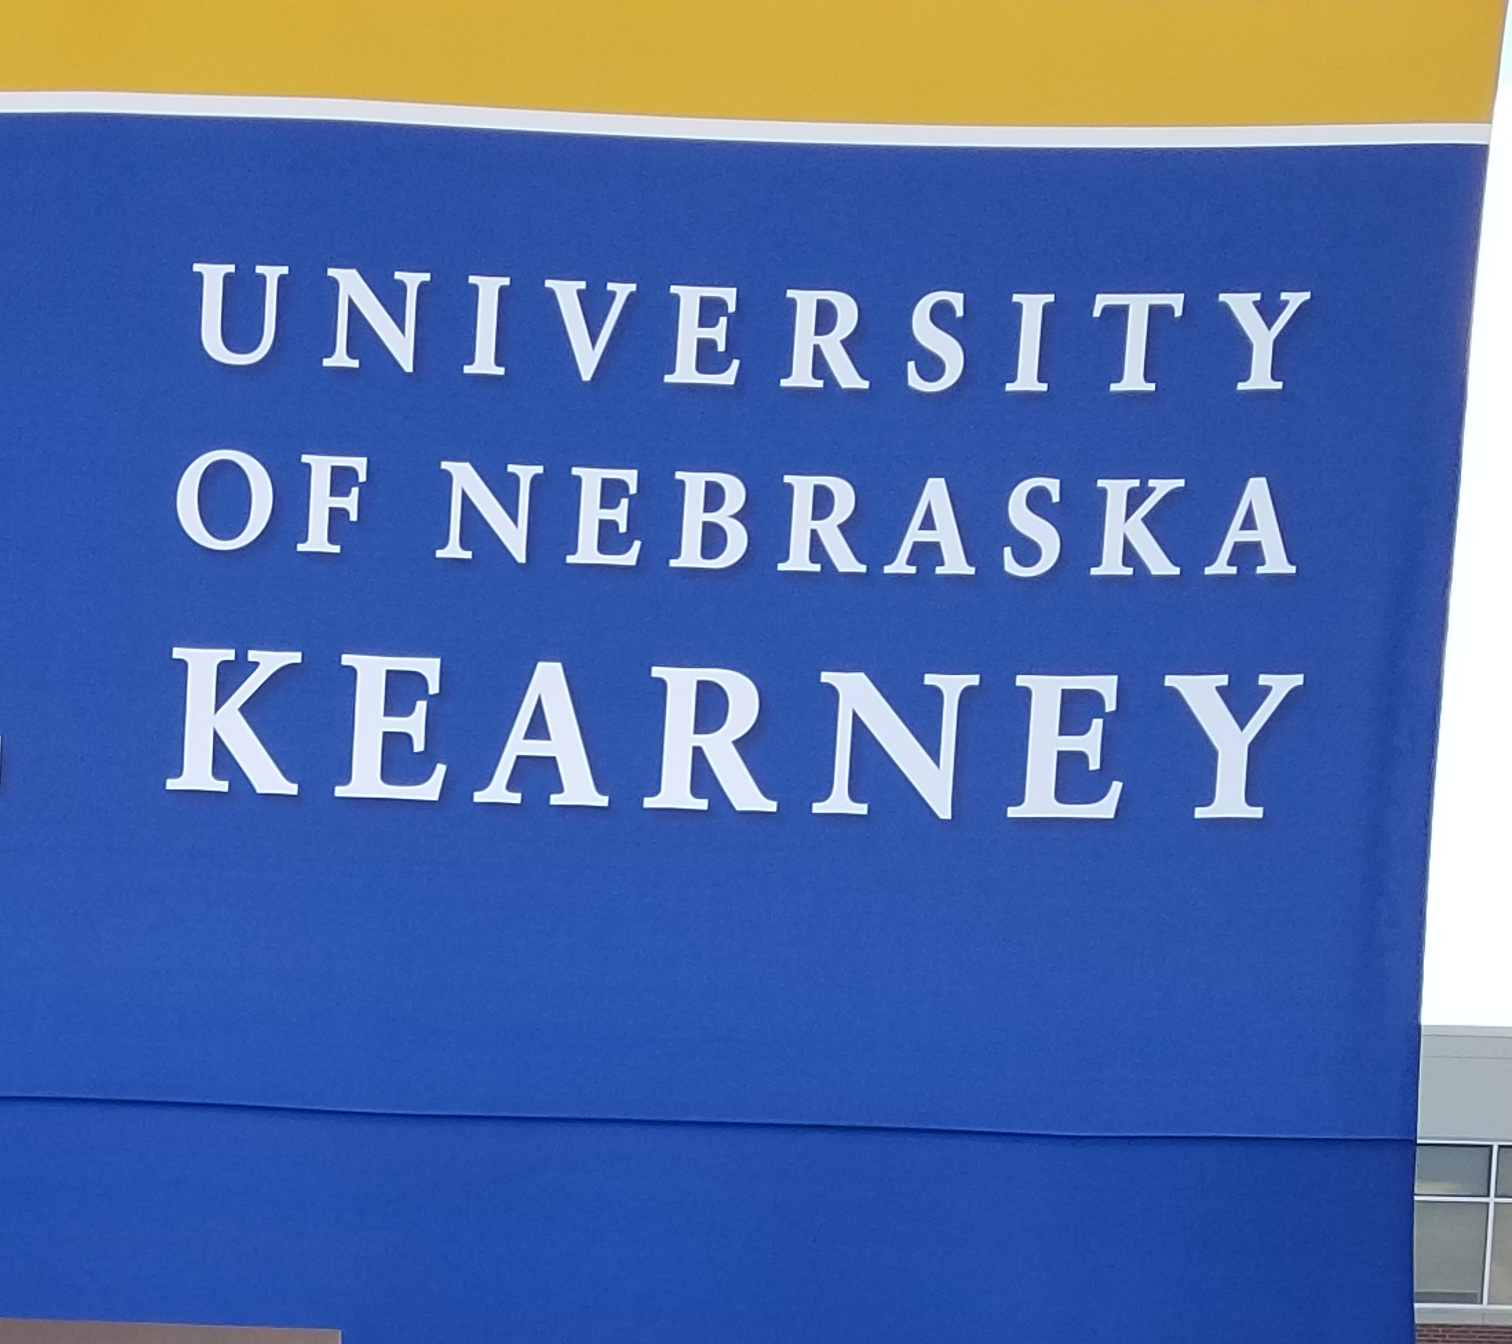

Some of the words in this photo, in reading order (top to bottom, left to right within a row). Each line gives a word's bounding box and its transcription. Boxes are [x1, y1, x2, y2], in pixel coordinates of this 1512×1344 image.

[191, 261, 1313, 394] UNIVERSITY
[175, 448, 369, 554] OF
[434, 459, 1299, 578] NEBRASKA
[164, 645, 1306, 821] KEARNEY
